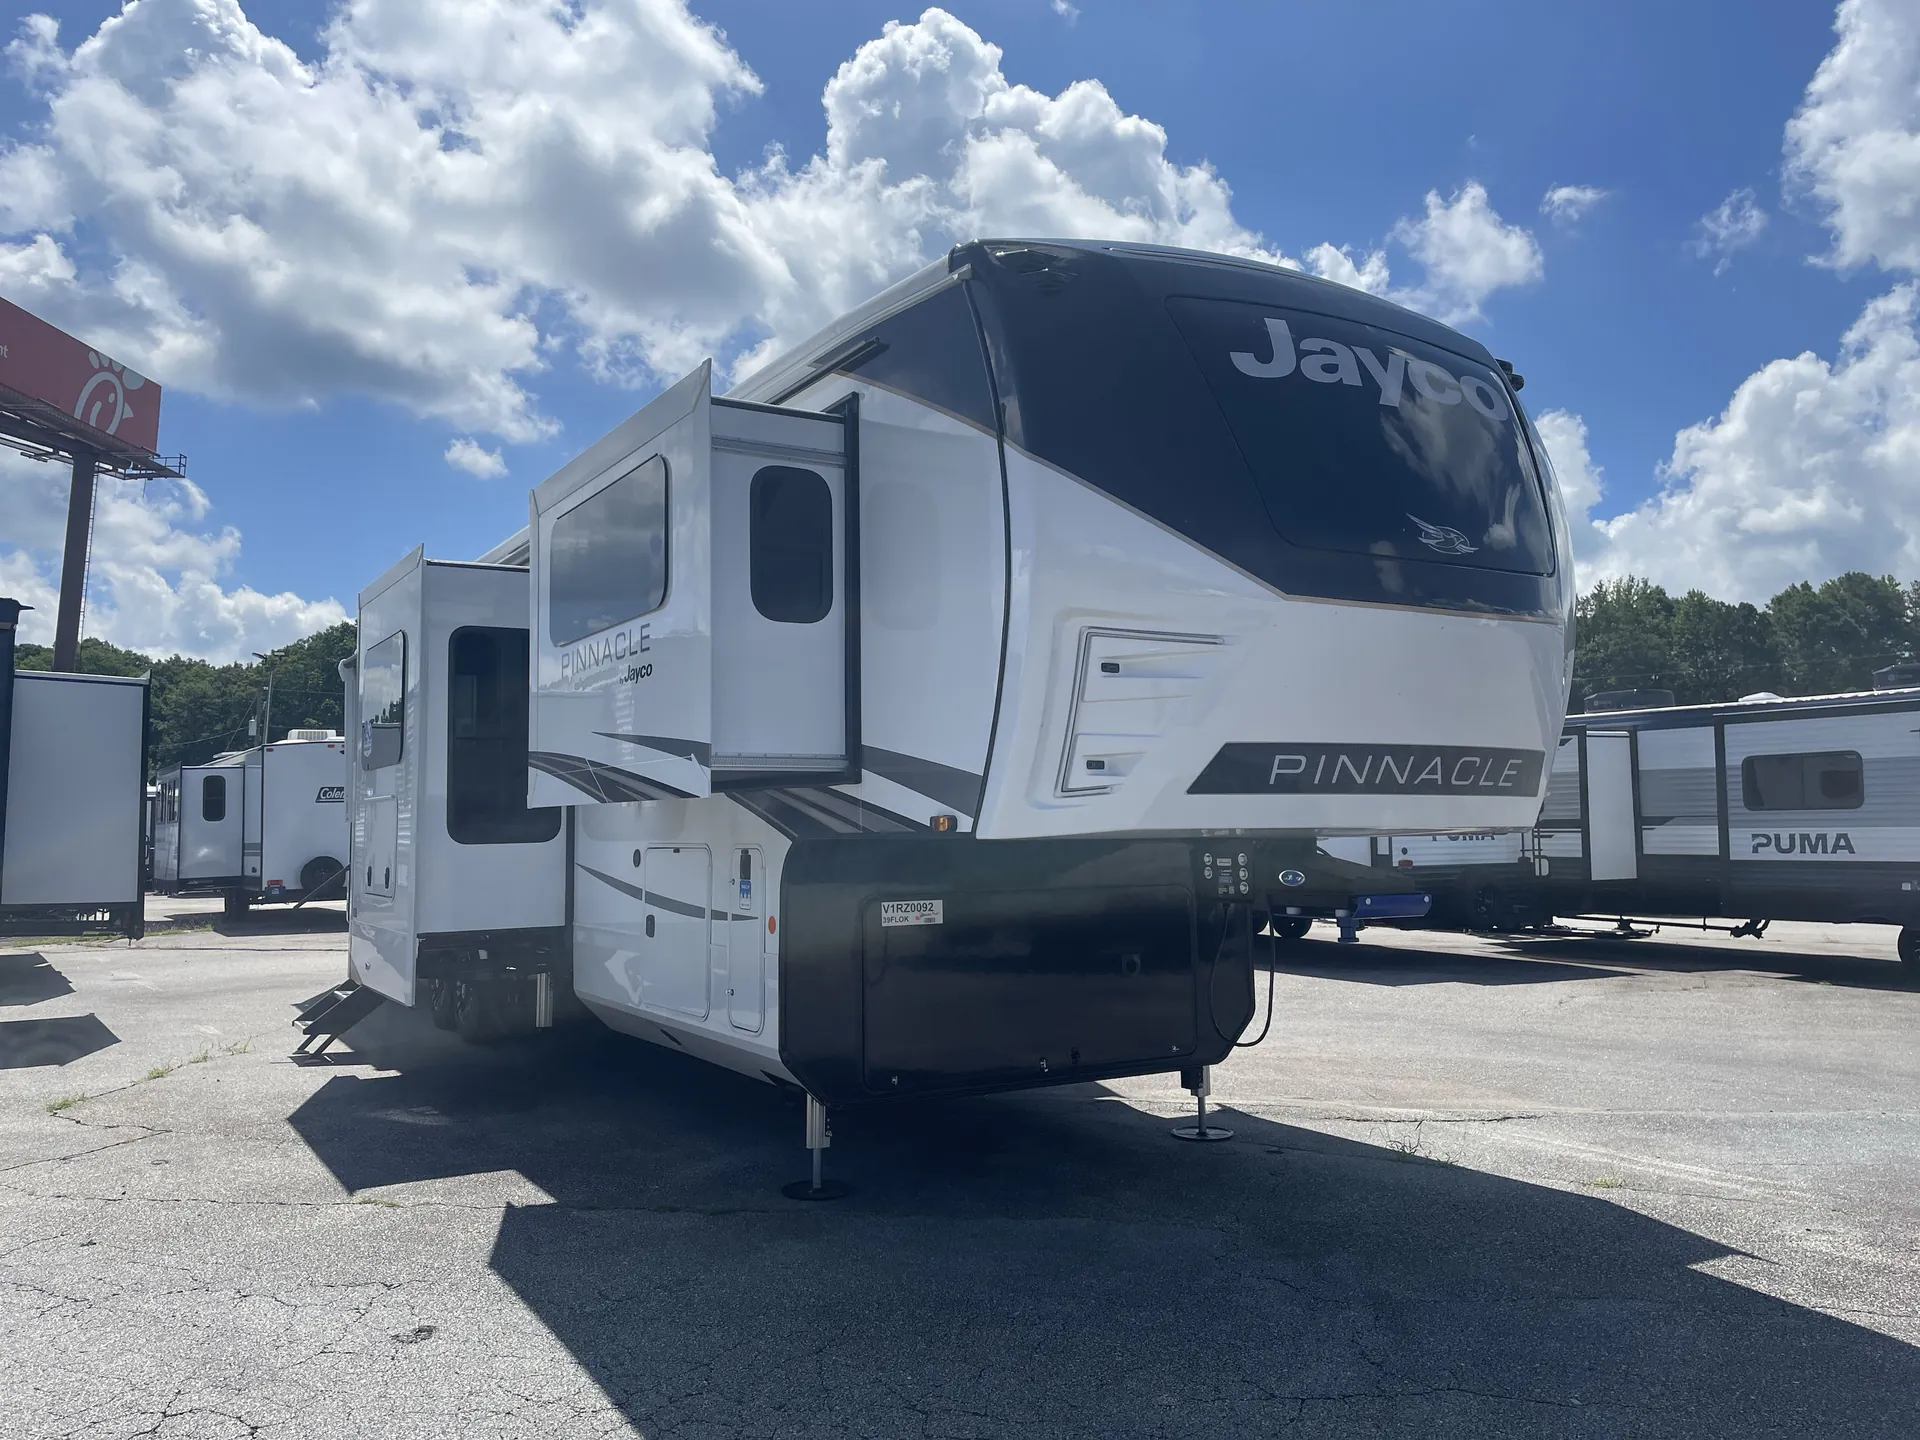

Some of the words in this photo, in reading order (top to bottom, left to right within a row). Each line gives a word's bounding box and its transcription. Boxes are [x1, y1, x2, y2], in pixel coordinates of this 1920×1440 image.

[1229, 317, 1509, 422] Jayco
[561, 623, 651, 679] PINNACLE
[624, 663, 653, 684] Jayco
[1269, 754, 1523, 787] PINNACLE
[1751, 832, 1856, 855] PUMA
[882, 902, 934, 914] V1RZ0092
